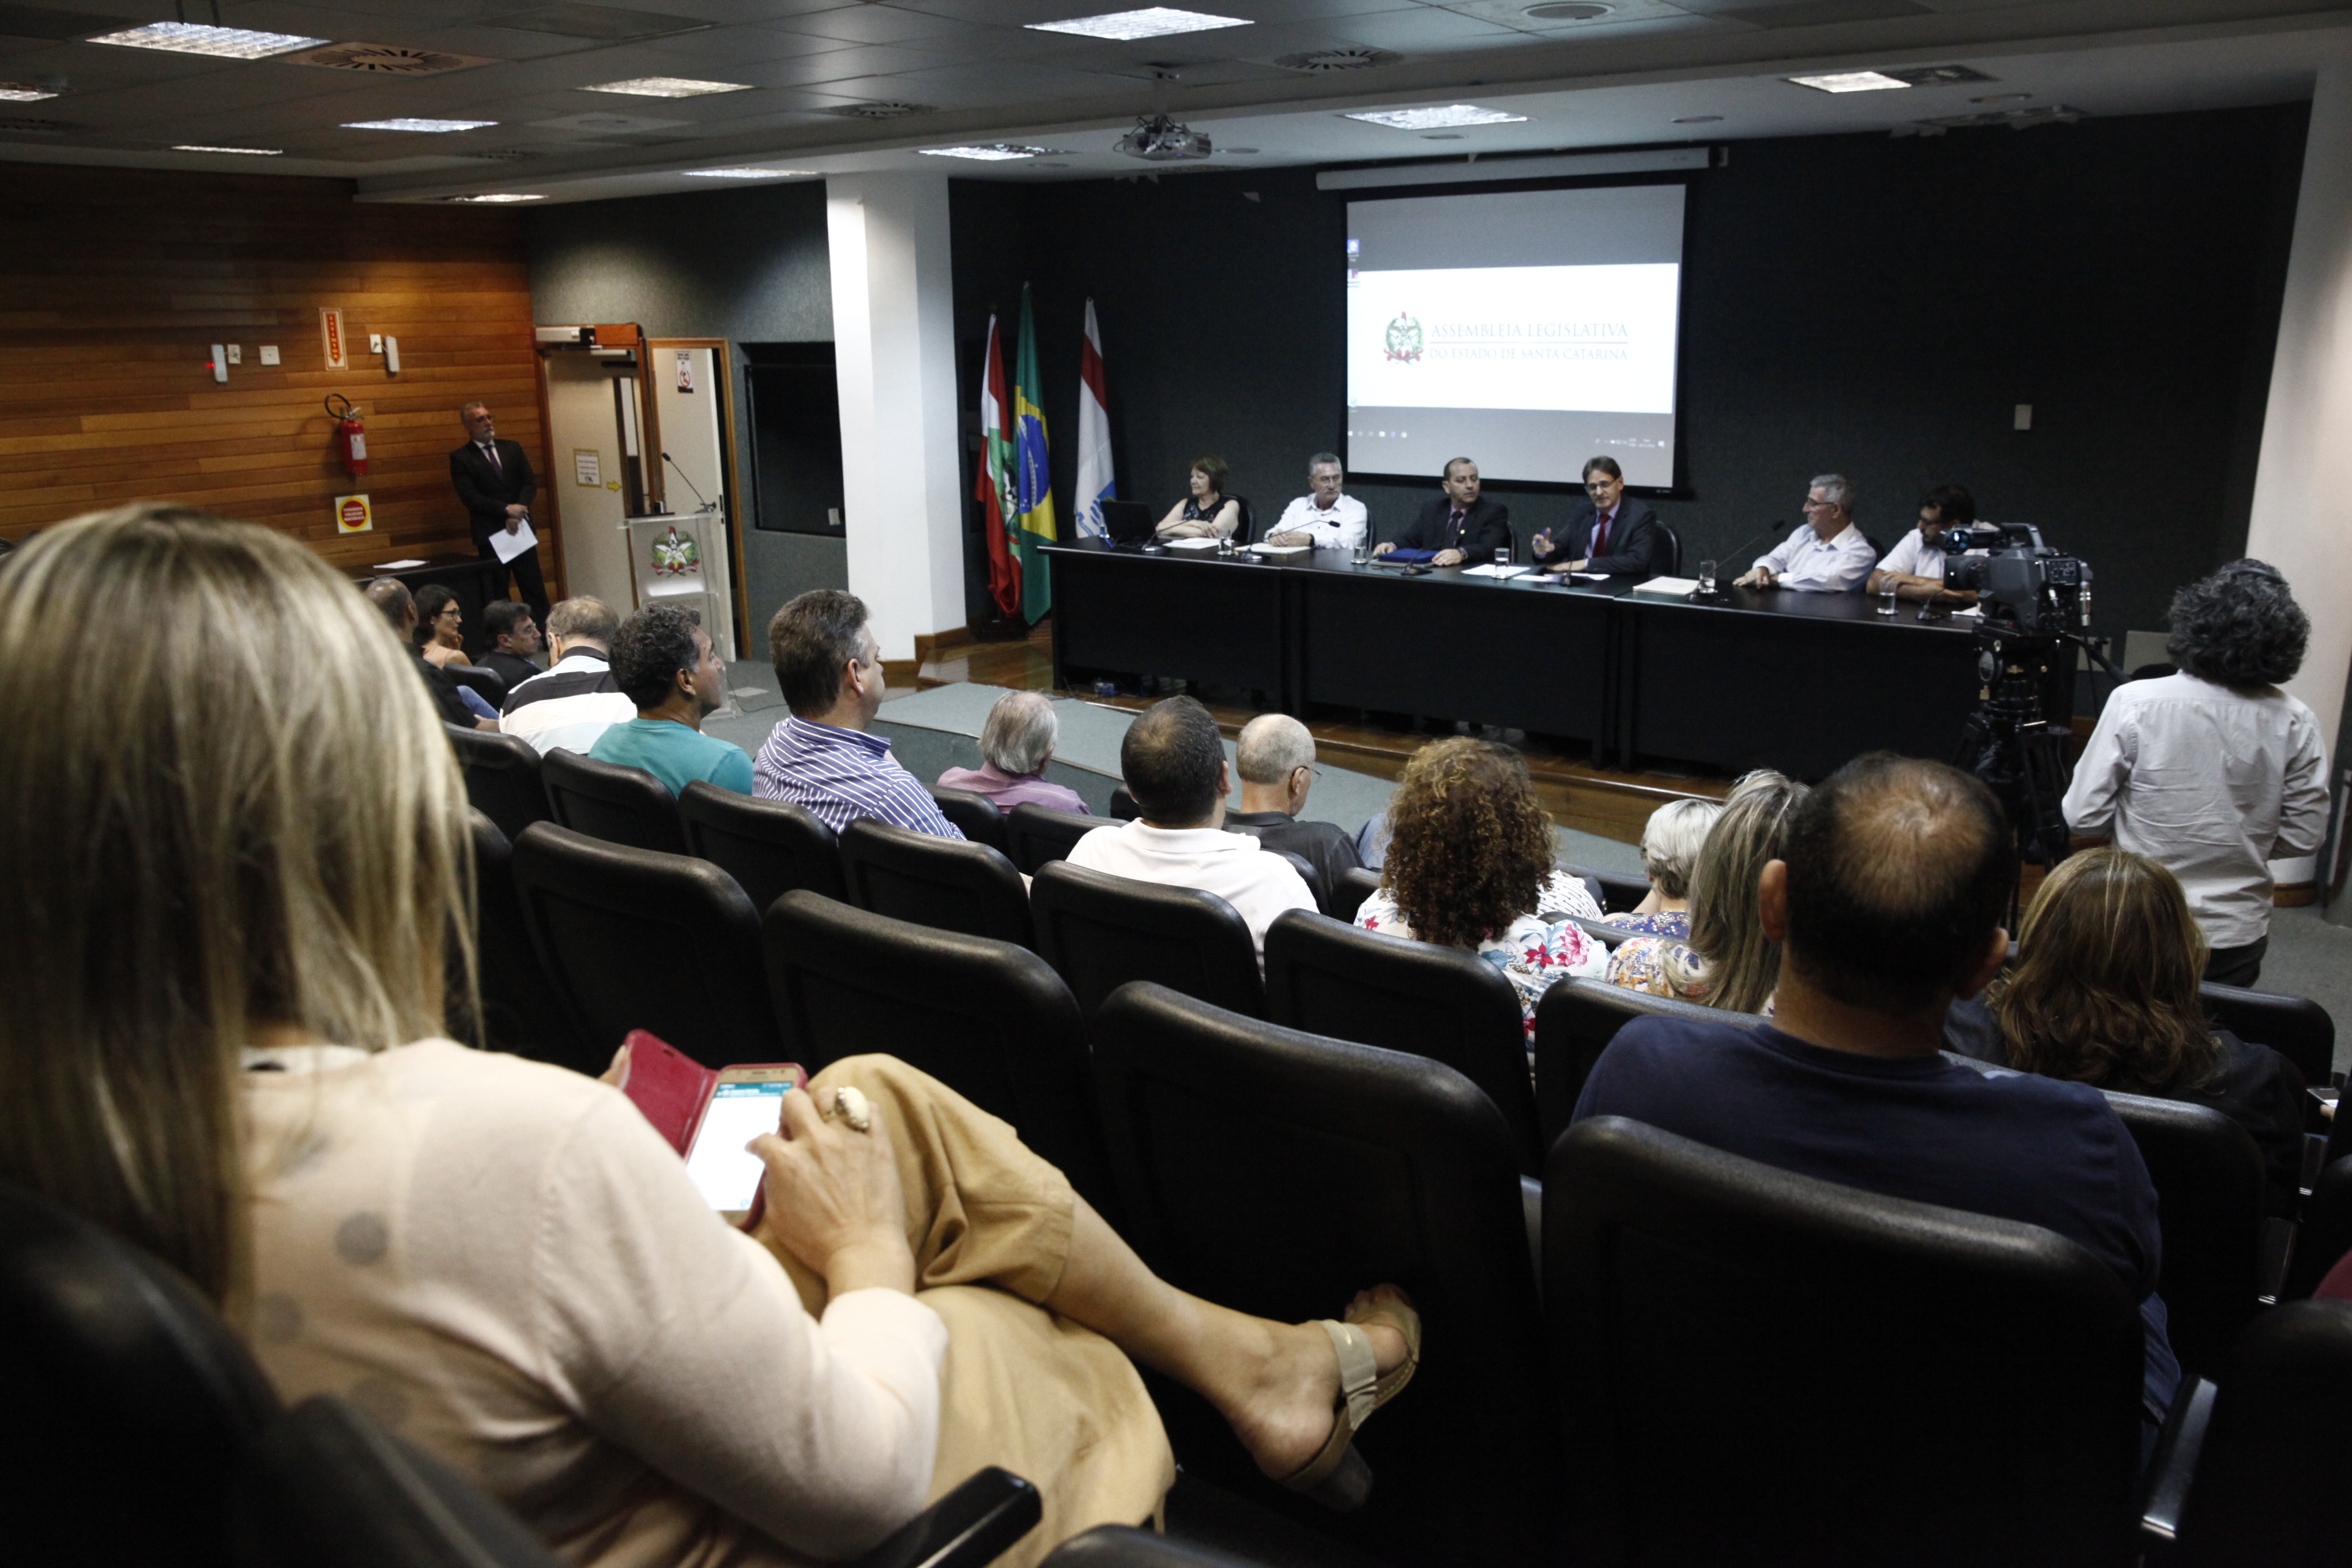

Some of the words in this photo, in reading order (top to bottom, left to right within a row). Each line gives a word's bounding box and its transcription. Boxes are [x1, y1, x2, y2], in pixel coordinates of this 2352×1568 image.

[1431, 323, 1522, 337] ASSEMBLEIA
[1528, 323, 1628, 337] LEGISLATIVA
[1430, 348, 1448, 359] DO
[1452, 348, 1497, 359] ESTADO
[1502, 348, 1516, 359] DE
[1521, 348, 1559, 359] SANTA
[1563, 348, 1628, 360] CATARINA
